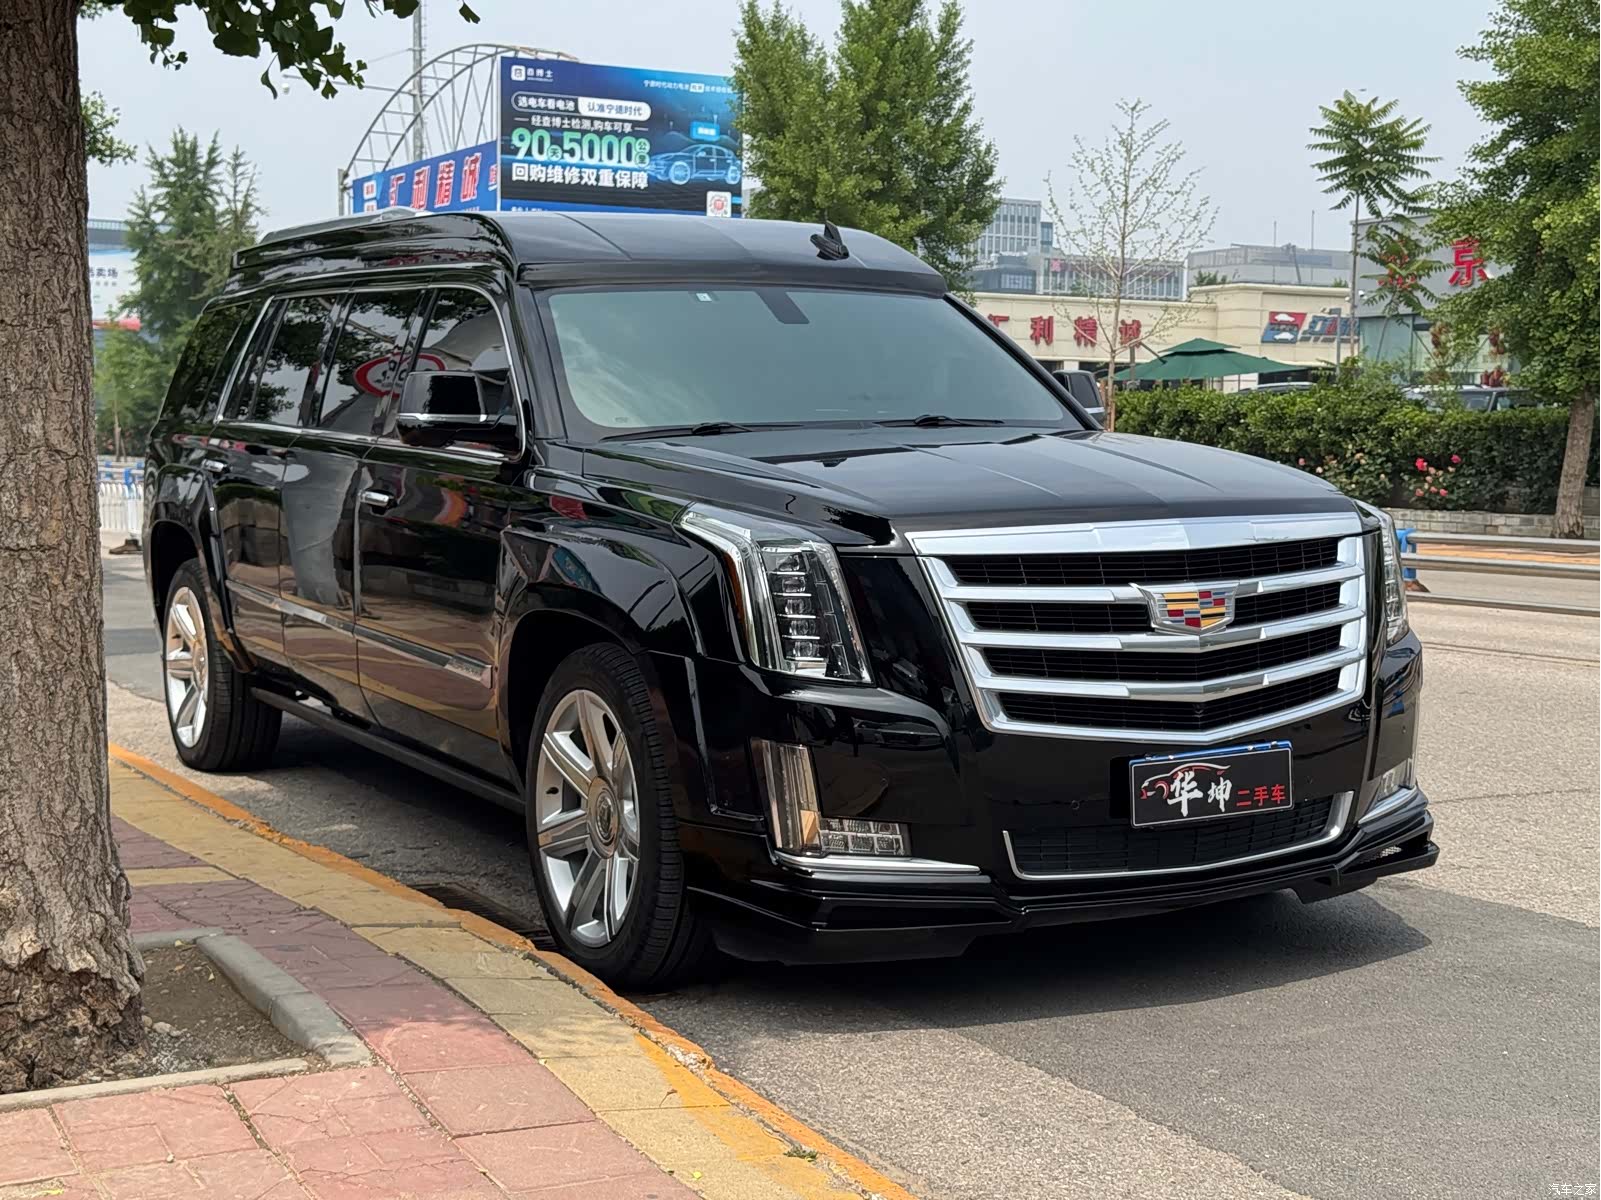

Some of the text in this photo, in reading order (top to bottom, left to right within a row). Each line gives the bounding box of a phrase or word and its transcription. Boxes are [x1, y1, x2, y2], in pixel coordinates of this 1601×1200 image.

[587, 101, 643, 116] 认准宁德时代
[511, 162, 649, 189] 回购维修双重保障
[1236, 784, 1287, 807] 二手车
